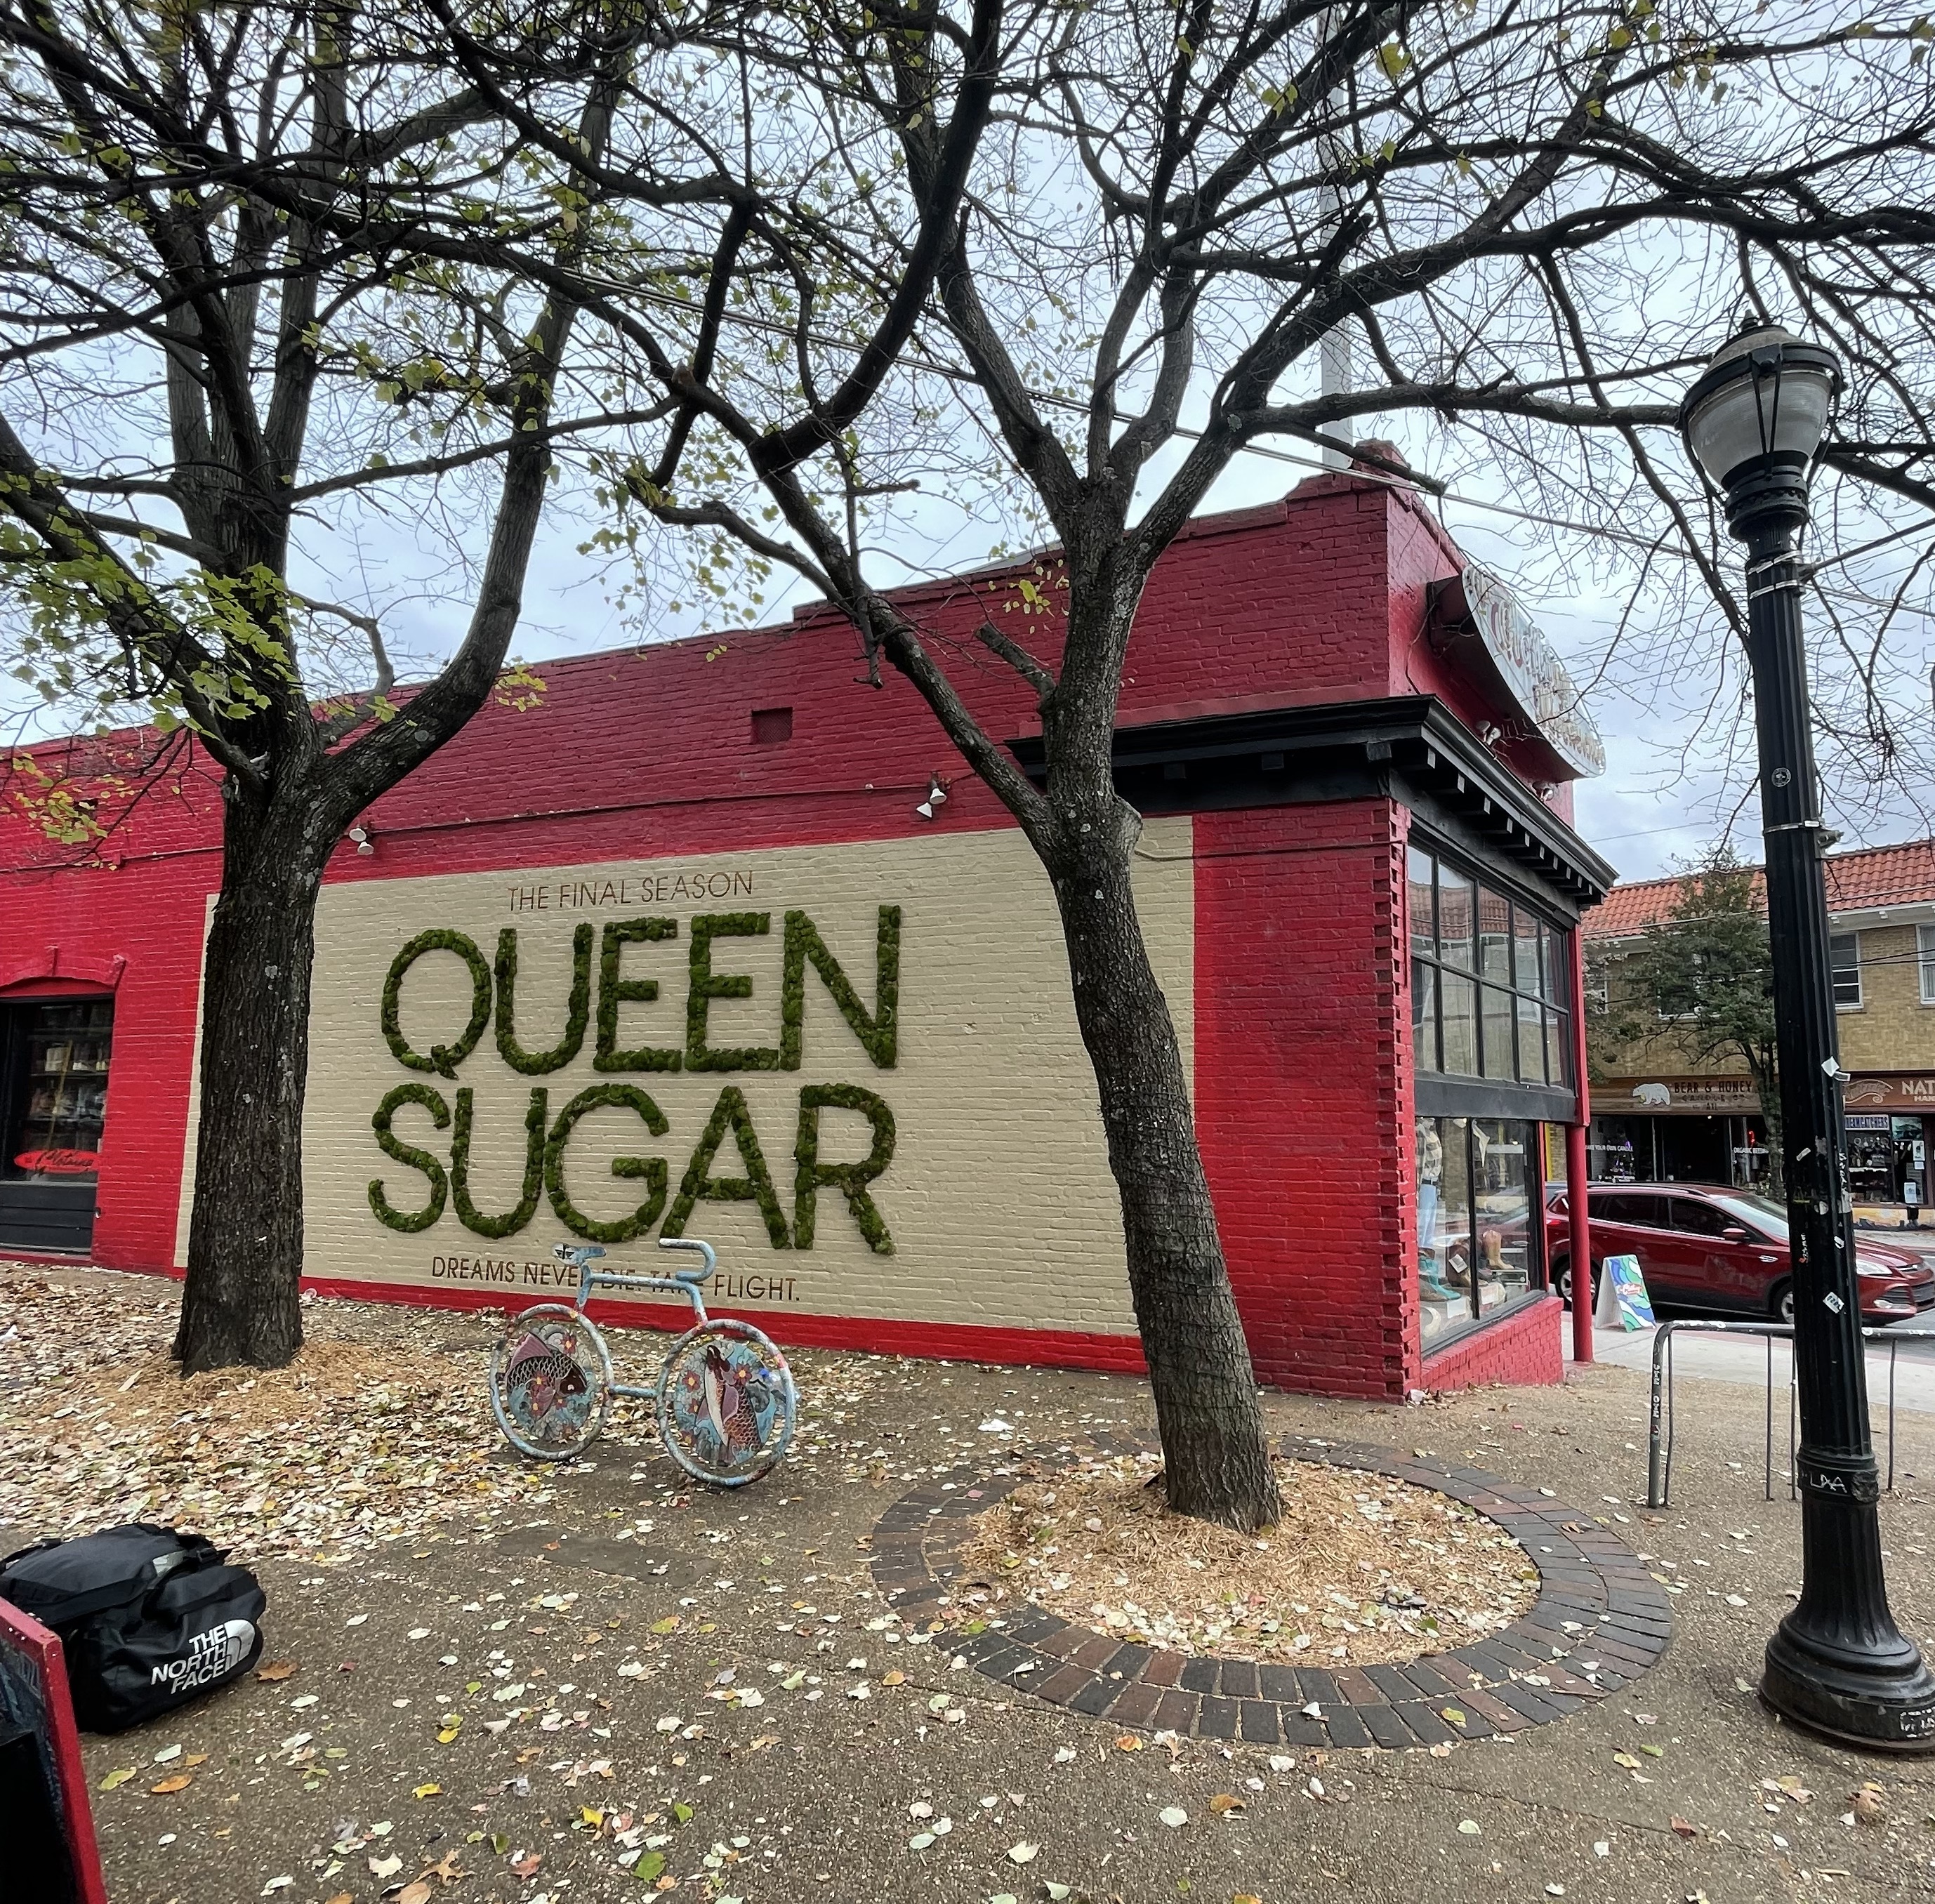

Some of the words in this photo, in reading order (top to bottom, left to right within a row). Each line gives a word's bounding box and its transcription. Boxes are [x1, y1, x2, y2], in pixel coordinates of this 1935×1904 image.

[508, 886, 549, 911] THE
[560, 880, 632, 908] FINAL
[641, 870, 753, 903] SEASON
[381, 905, 901, 1080] QUEEN
[1674, 1082, 1699, 1093] BEAR
[1705, 1081, 1712, 1092] &
[1718, 1080, 1752, 1092] HONEY
[367, 1083, 897, 1255] SUGAR
[431, 1255, 516, 1282] DREAMS
[523, 1262, 583, 1288] NEVE
[714, 1276, 800, 1302] FLIGHT.
[188, 1624, 227, 1654] THE
[150, 1641, 227, 1685] NORTH
[171, 1658, 226, 1694] FACE
